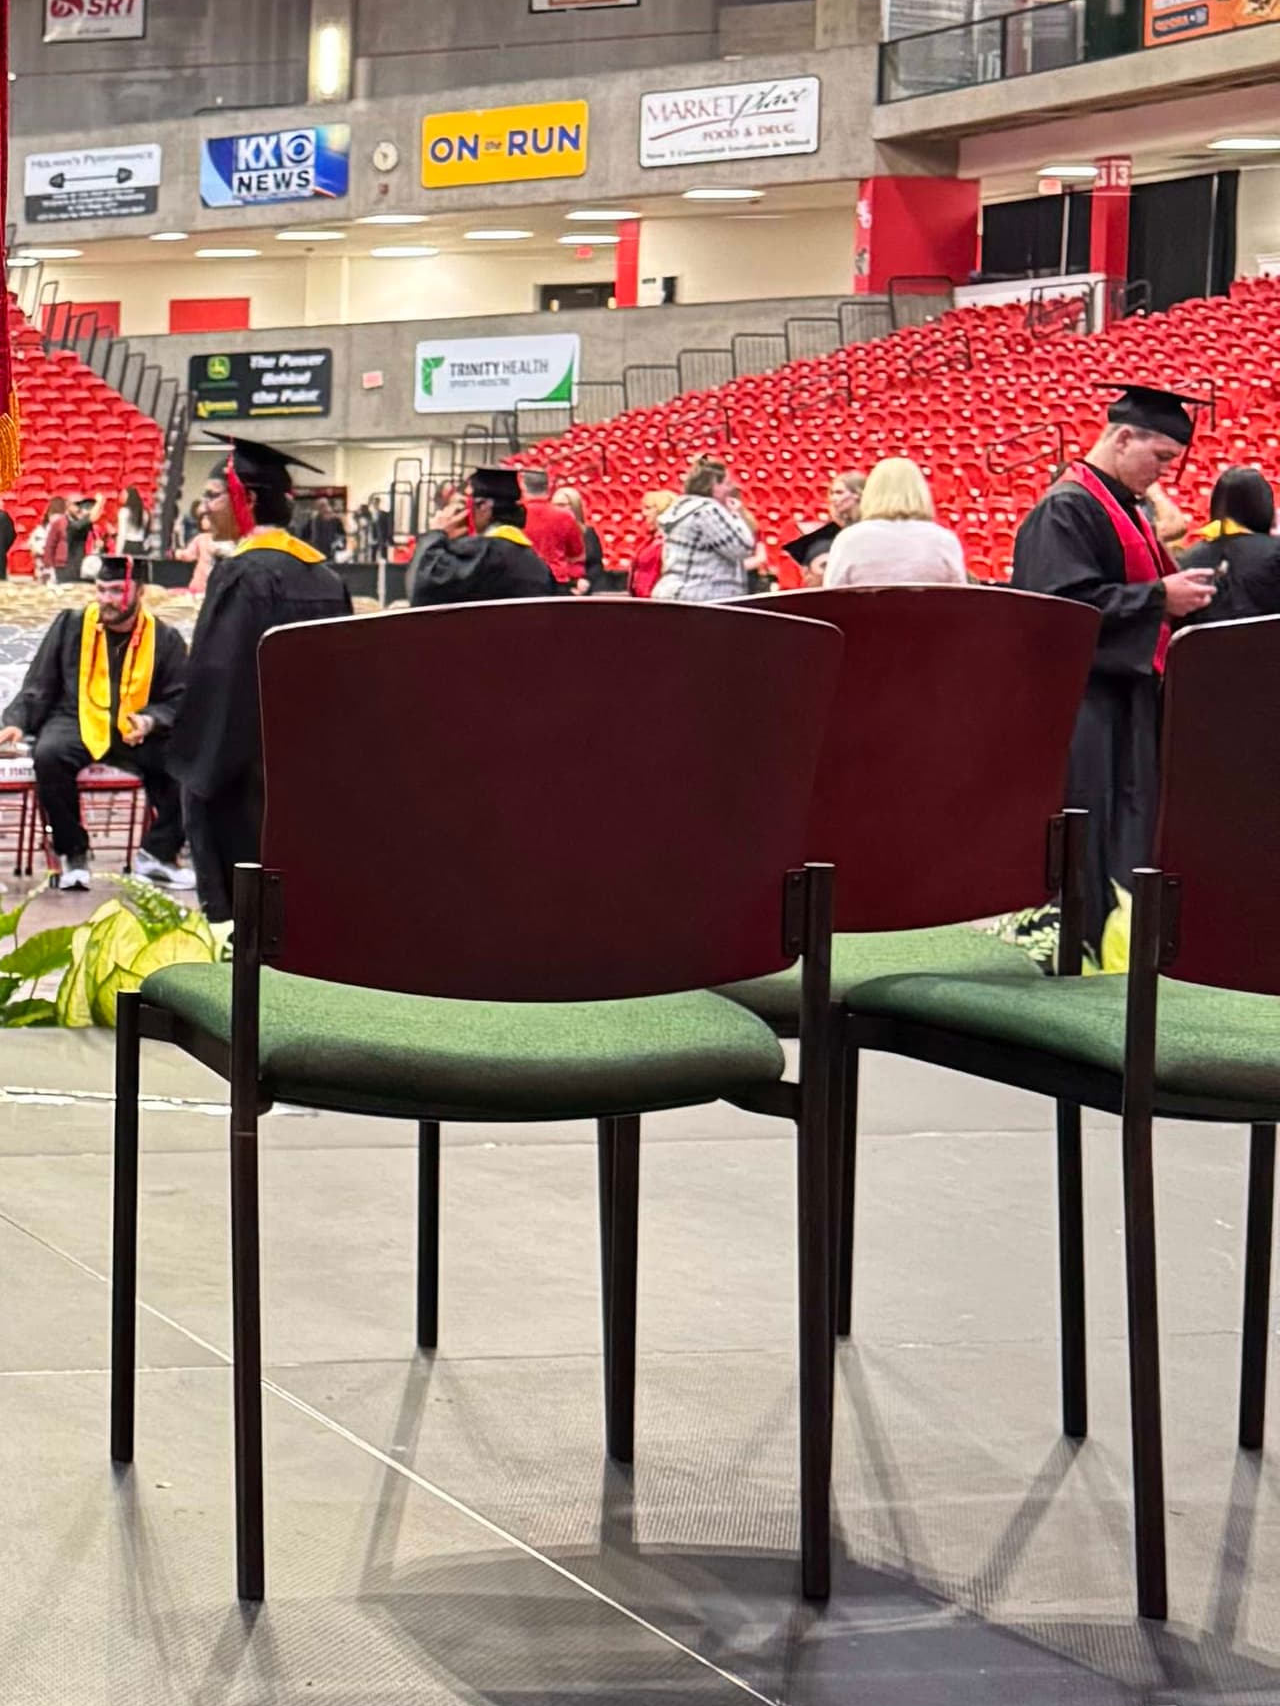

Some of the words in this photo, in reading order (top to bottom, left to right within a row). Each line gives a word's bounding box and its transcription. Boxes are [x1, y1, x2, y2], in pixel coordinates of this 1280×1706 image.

[647, 95, 738, 122] MARKET
[430, 134, 479, 163] ON
[508, 124, 581, 156] RUN
[703, 128, 738, 141] FOOD
[744, 127, 753, 137] &
[758, 123, 794, 136] DRUG
[237, 135, 278, 170] KX
[237, 170, 311, 194] NEWS
[450, 361, 501, 378] TRINITY
[502, 358, 549, 375] HEALTH
